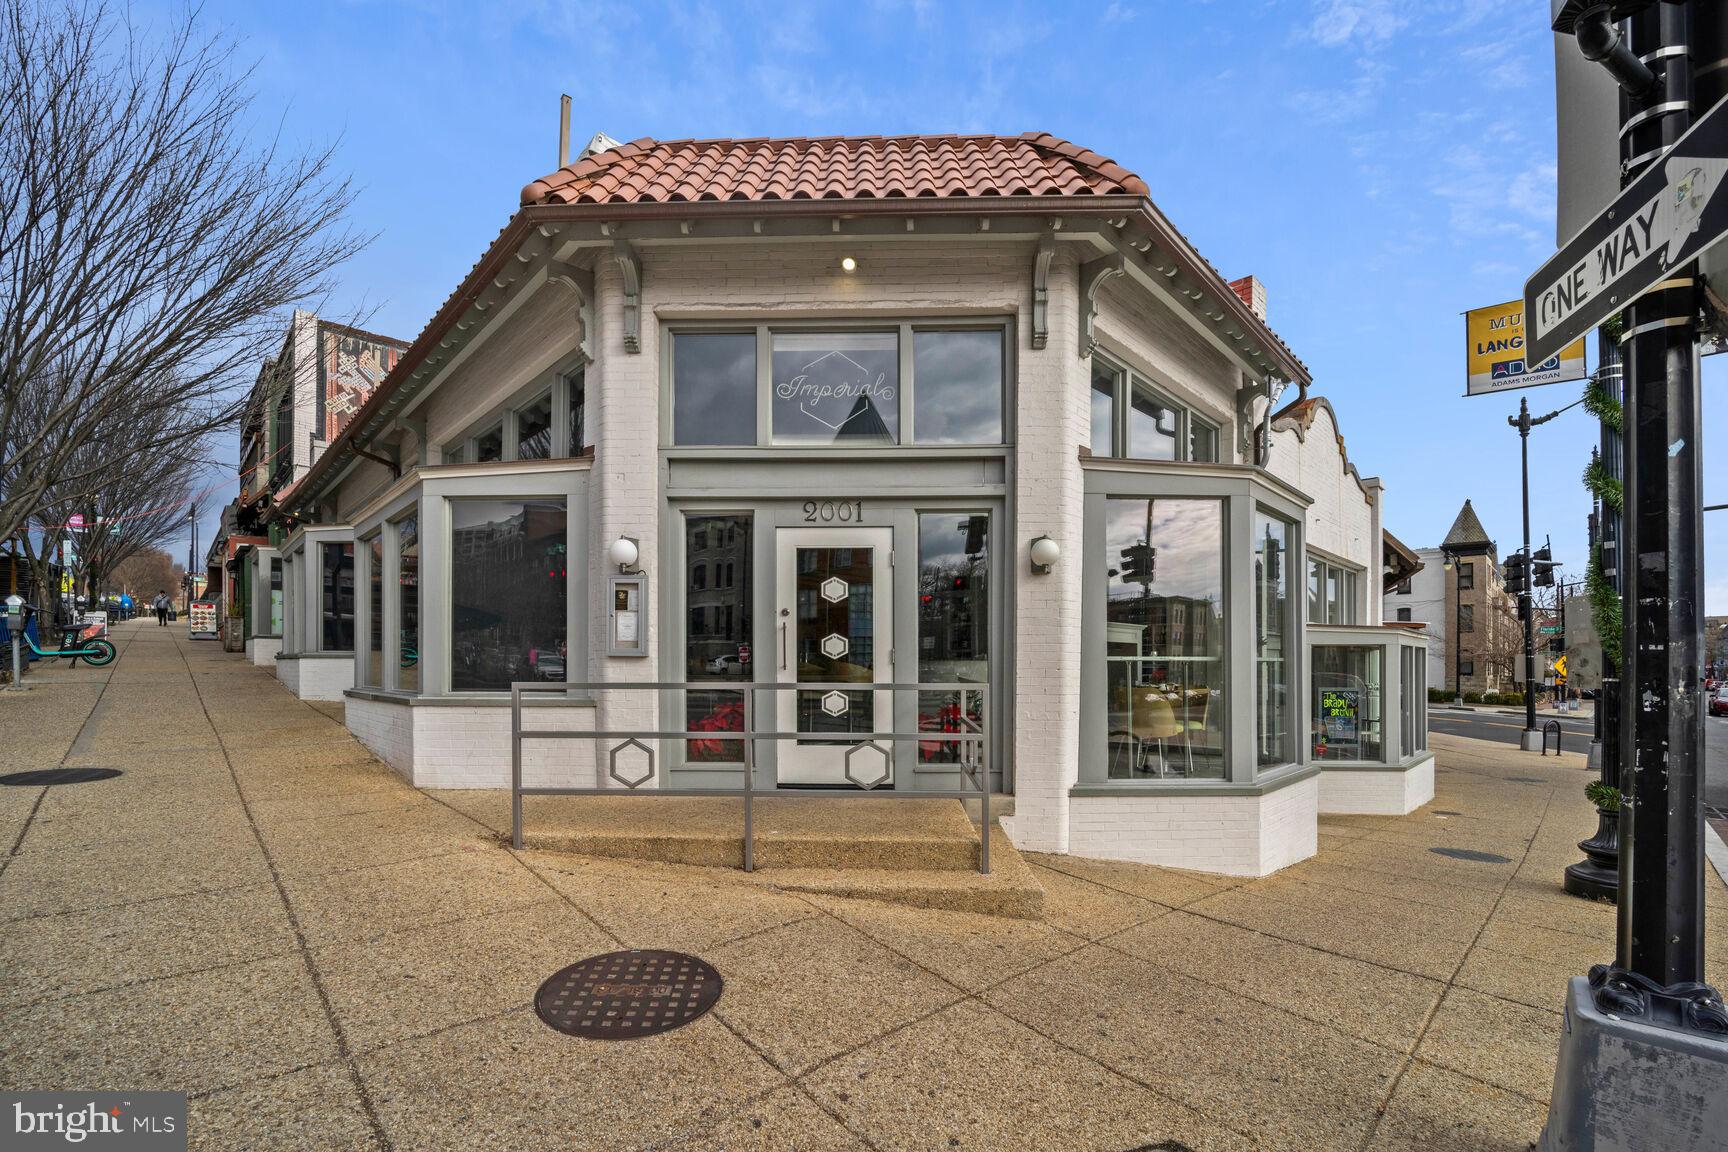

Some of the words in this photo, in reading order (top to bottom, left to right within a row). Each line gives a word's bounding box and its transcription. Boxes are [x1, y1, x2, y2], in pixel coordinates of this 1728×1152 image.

[1541, 262, 1589, 327] ONE
[1597, 199, 1660, 286] WAY
[1489, 312, 1522, 330] MU
[1477, 336, 1524, 355] LANG
[1493, 356, 1558, 377] ADO
[776, 372, 896, 406] Imperial
[1491, 377, 1521, 388] ADAMS
[1522, 372, 1560, 383] MORGAN
[803, 501, 864, 523] 2001
[64, 633, 73, 647] veo
